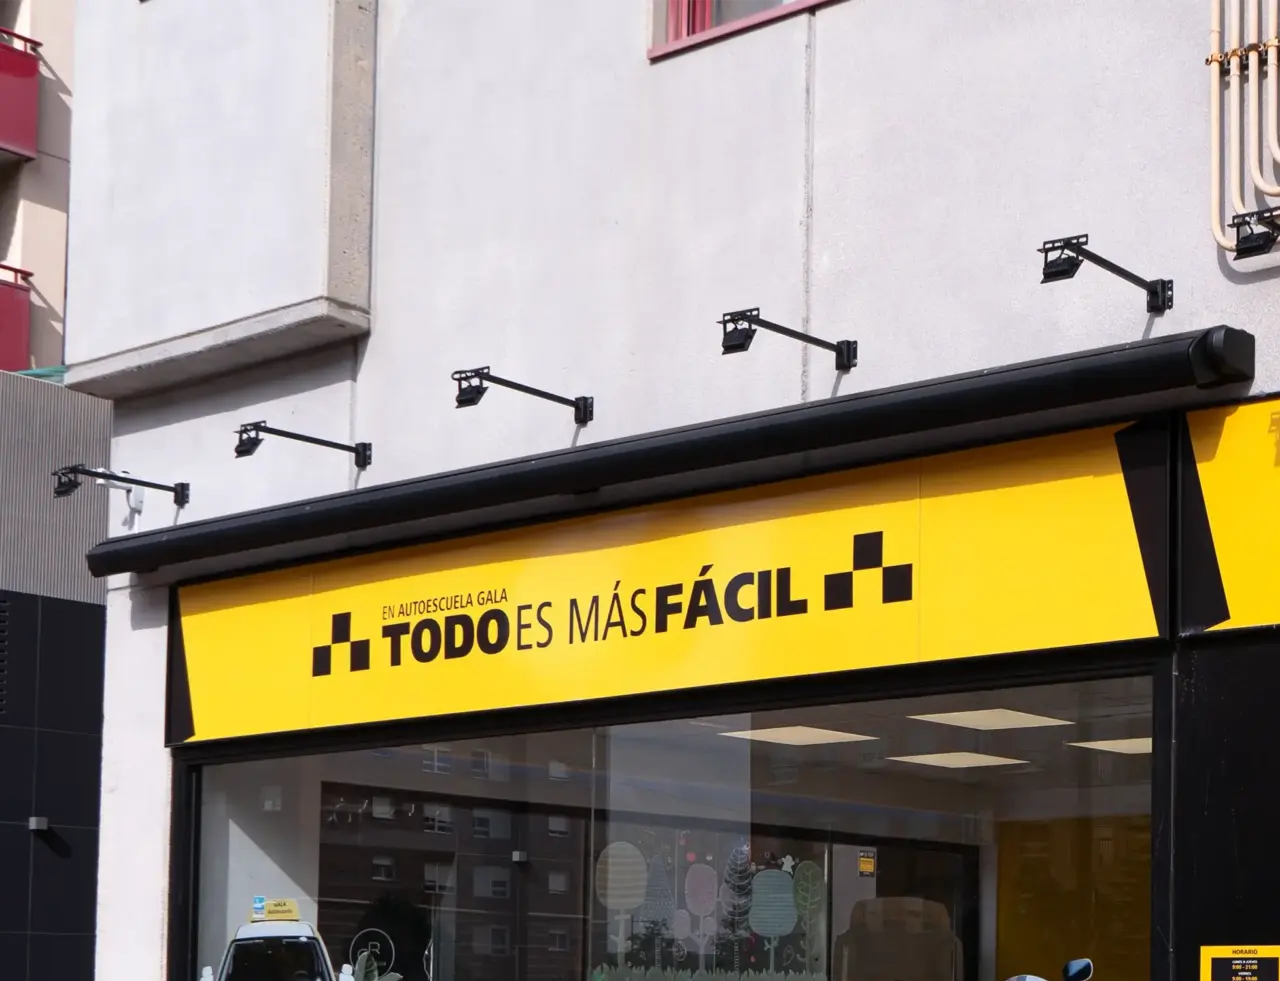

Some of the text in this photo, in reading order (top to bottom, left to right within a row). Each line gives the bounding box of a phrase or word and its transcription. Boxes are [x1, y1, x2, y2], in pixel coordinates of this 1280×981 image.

[382, 588, 508, 620] EN AUTOESCUELA GALA
[382, 564, 808, 667] TODO ES MÁS FÁCIL
